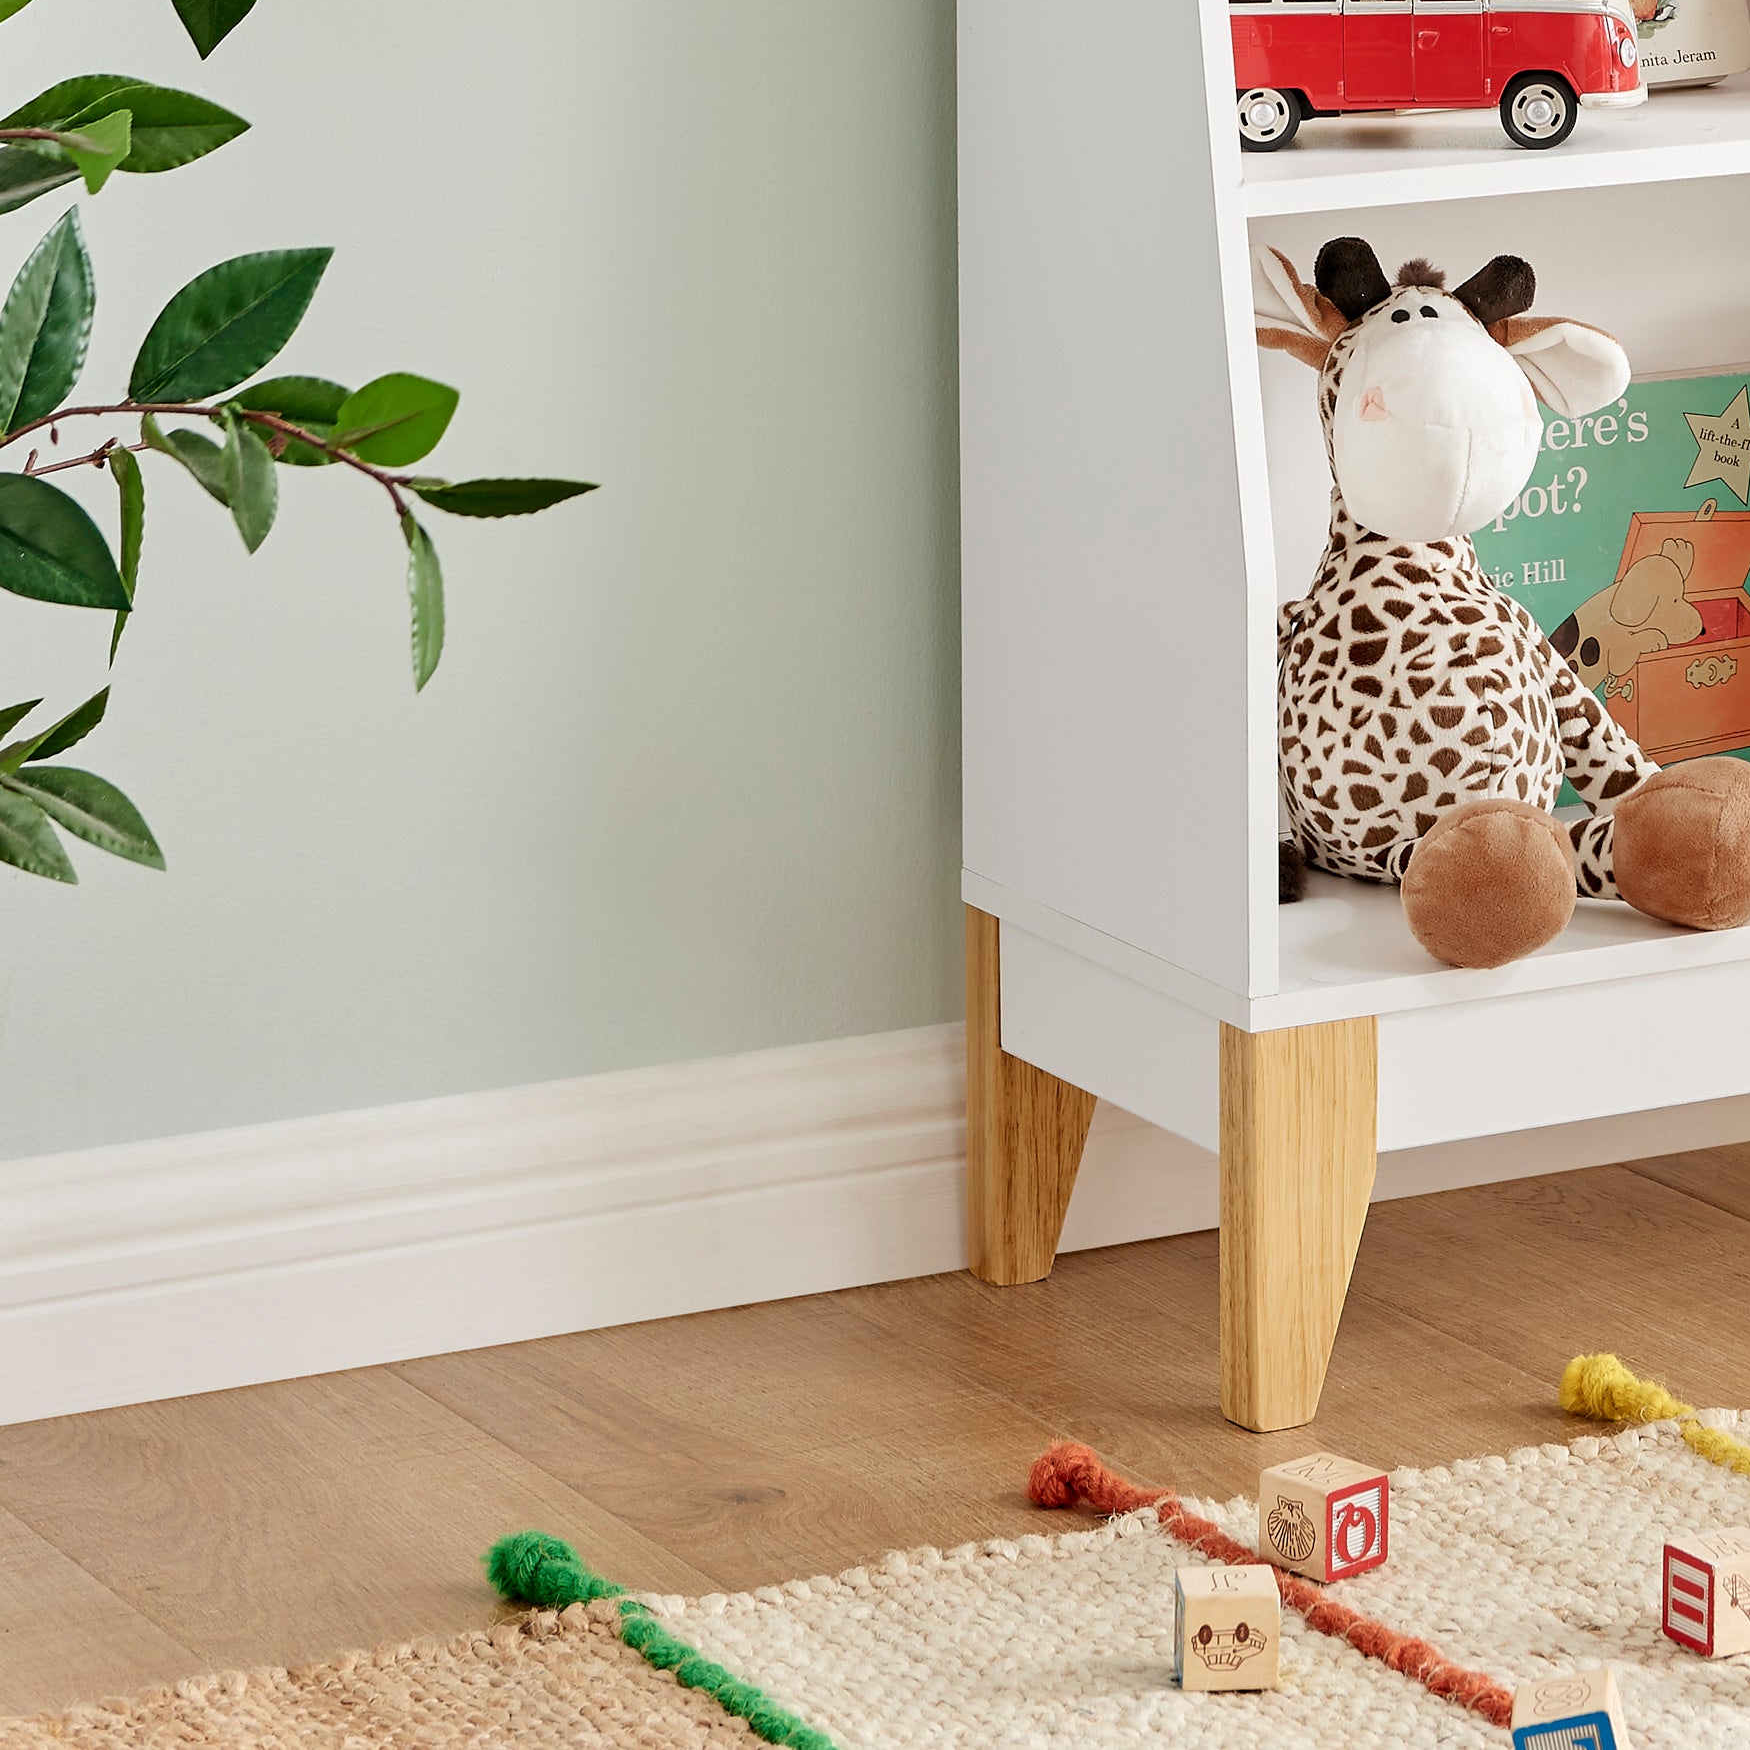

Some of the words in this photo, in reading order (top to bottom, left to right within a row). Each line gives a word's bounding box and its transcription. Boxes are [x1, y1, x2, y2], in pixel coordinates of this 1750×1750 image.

[1639, 52, 1669, 68] nita
[1673, 49, 1717, 64] Jeram
[1538, 398, 1649, 452] ere's
[1730, 418, 1740, 430] A
[1713, 450, 1741, 467] book
[1521, 558, 1567, 585] Hill
